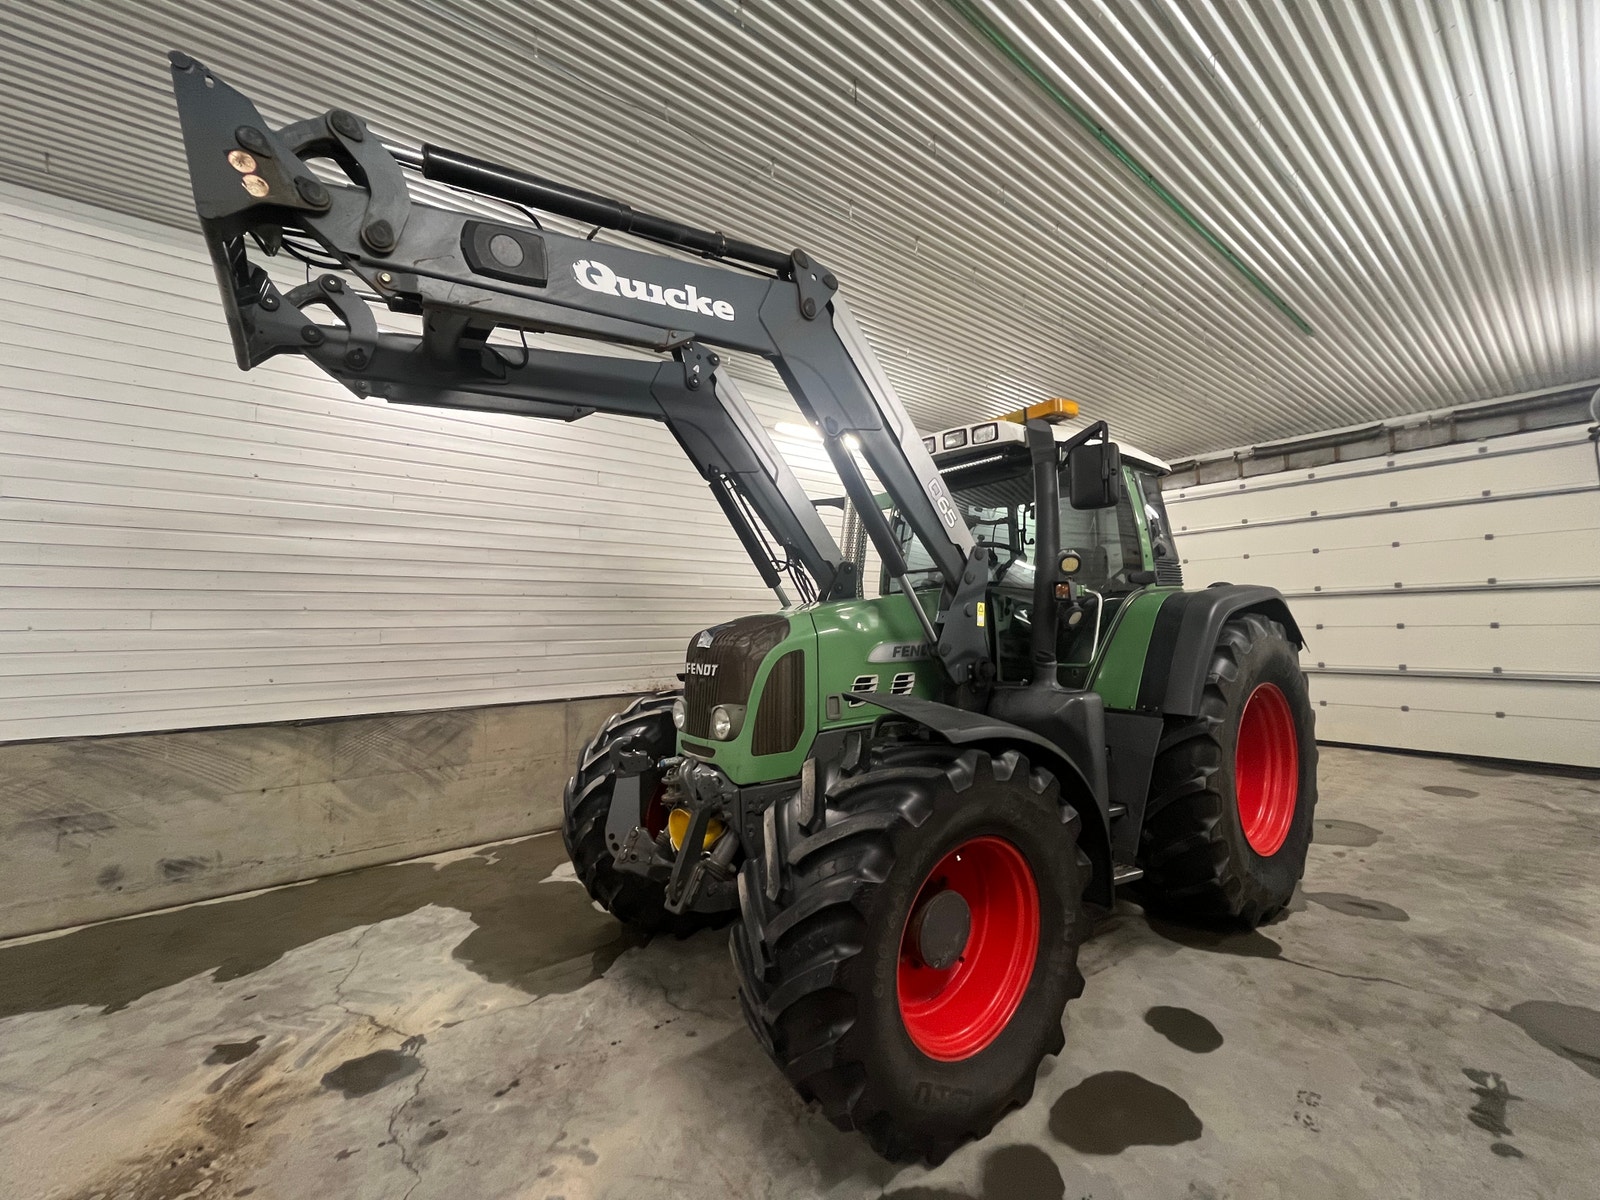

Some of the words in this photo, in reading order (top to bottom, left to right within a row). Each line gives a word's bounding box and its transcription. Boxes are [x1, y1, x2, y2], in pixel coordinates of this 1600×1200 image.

[572, 259, 735, 322] Quicke
[928, 477, 957, 528] Q65
[686, 662, 719, 677] FENDT
